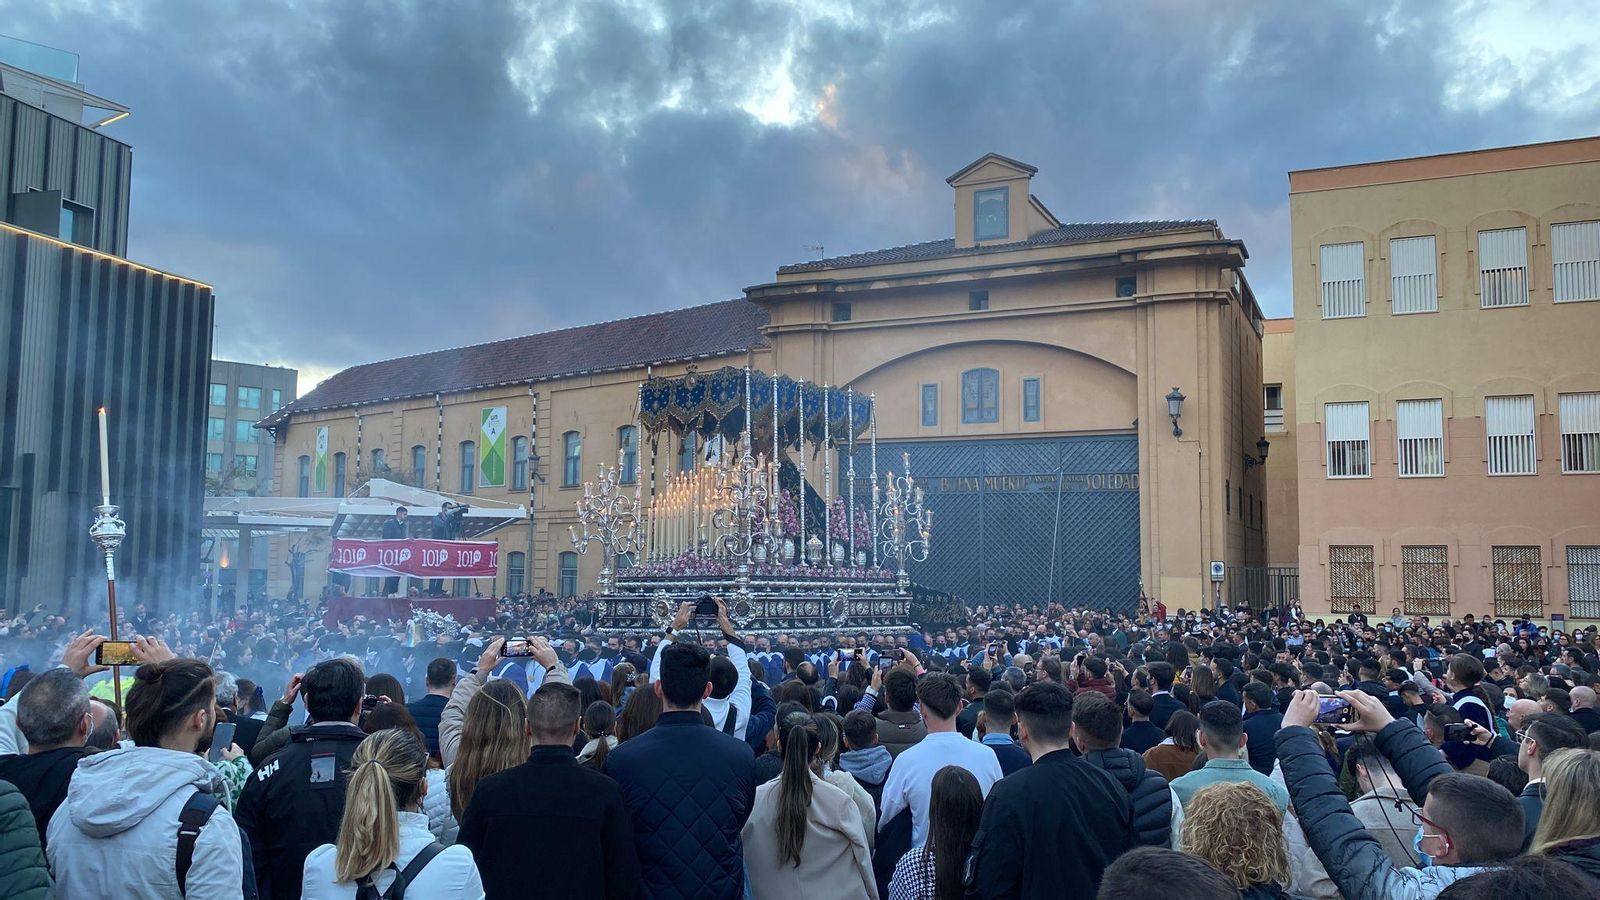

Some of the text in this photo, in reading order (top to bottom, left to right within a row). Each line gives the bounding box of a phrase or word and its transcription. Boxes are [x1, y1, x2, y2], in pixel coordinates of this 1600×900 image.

[983, 475, 1029, 491] MUERTE
[1086, 473, 1140, 489] SOLEDAD
[338, 548, 356, 564] 101
[378, 549, 400, 566] 101
[422, 549, 440, 567] 101
[456, 550, 473, 567] 101
